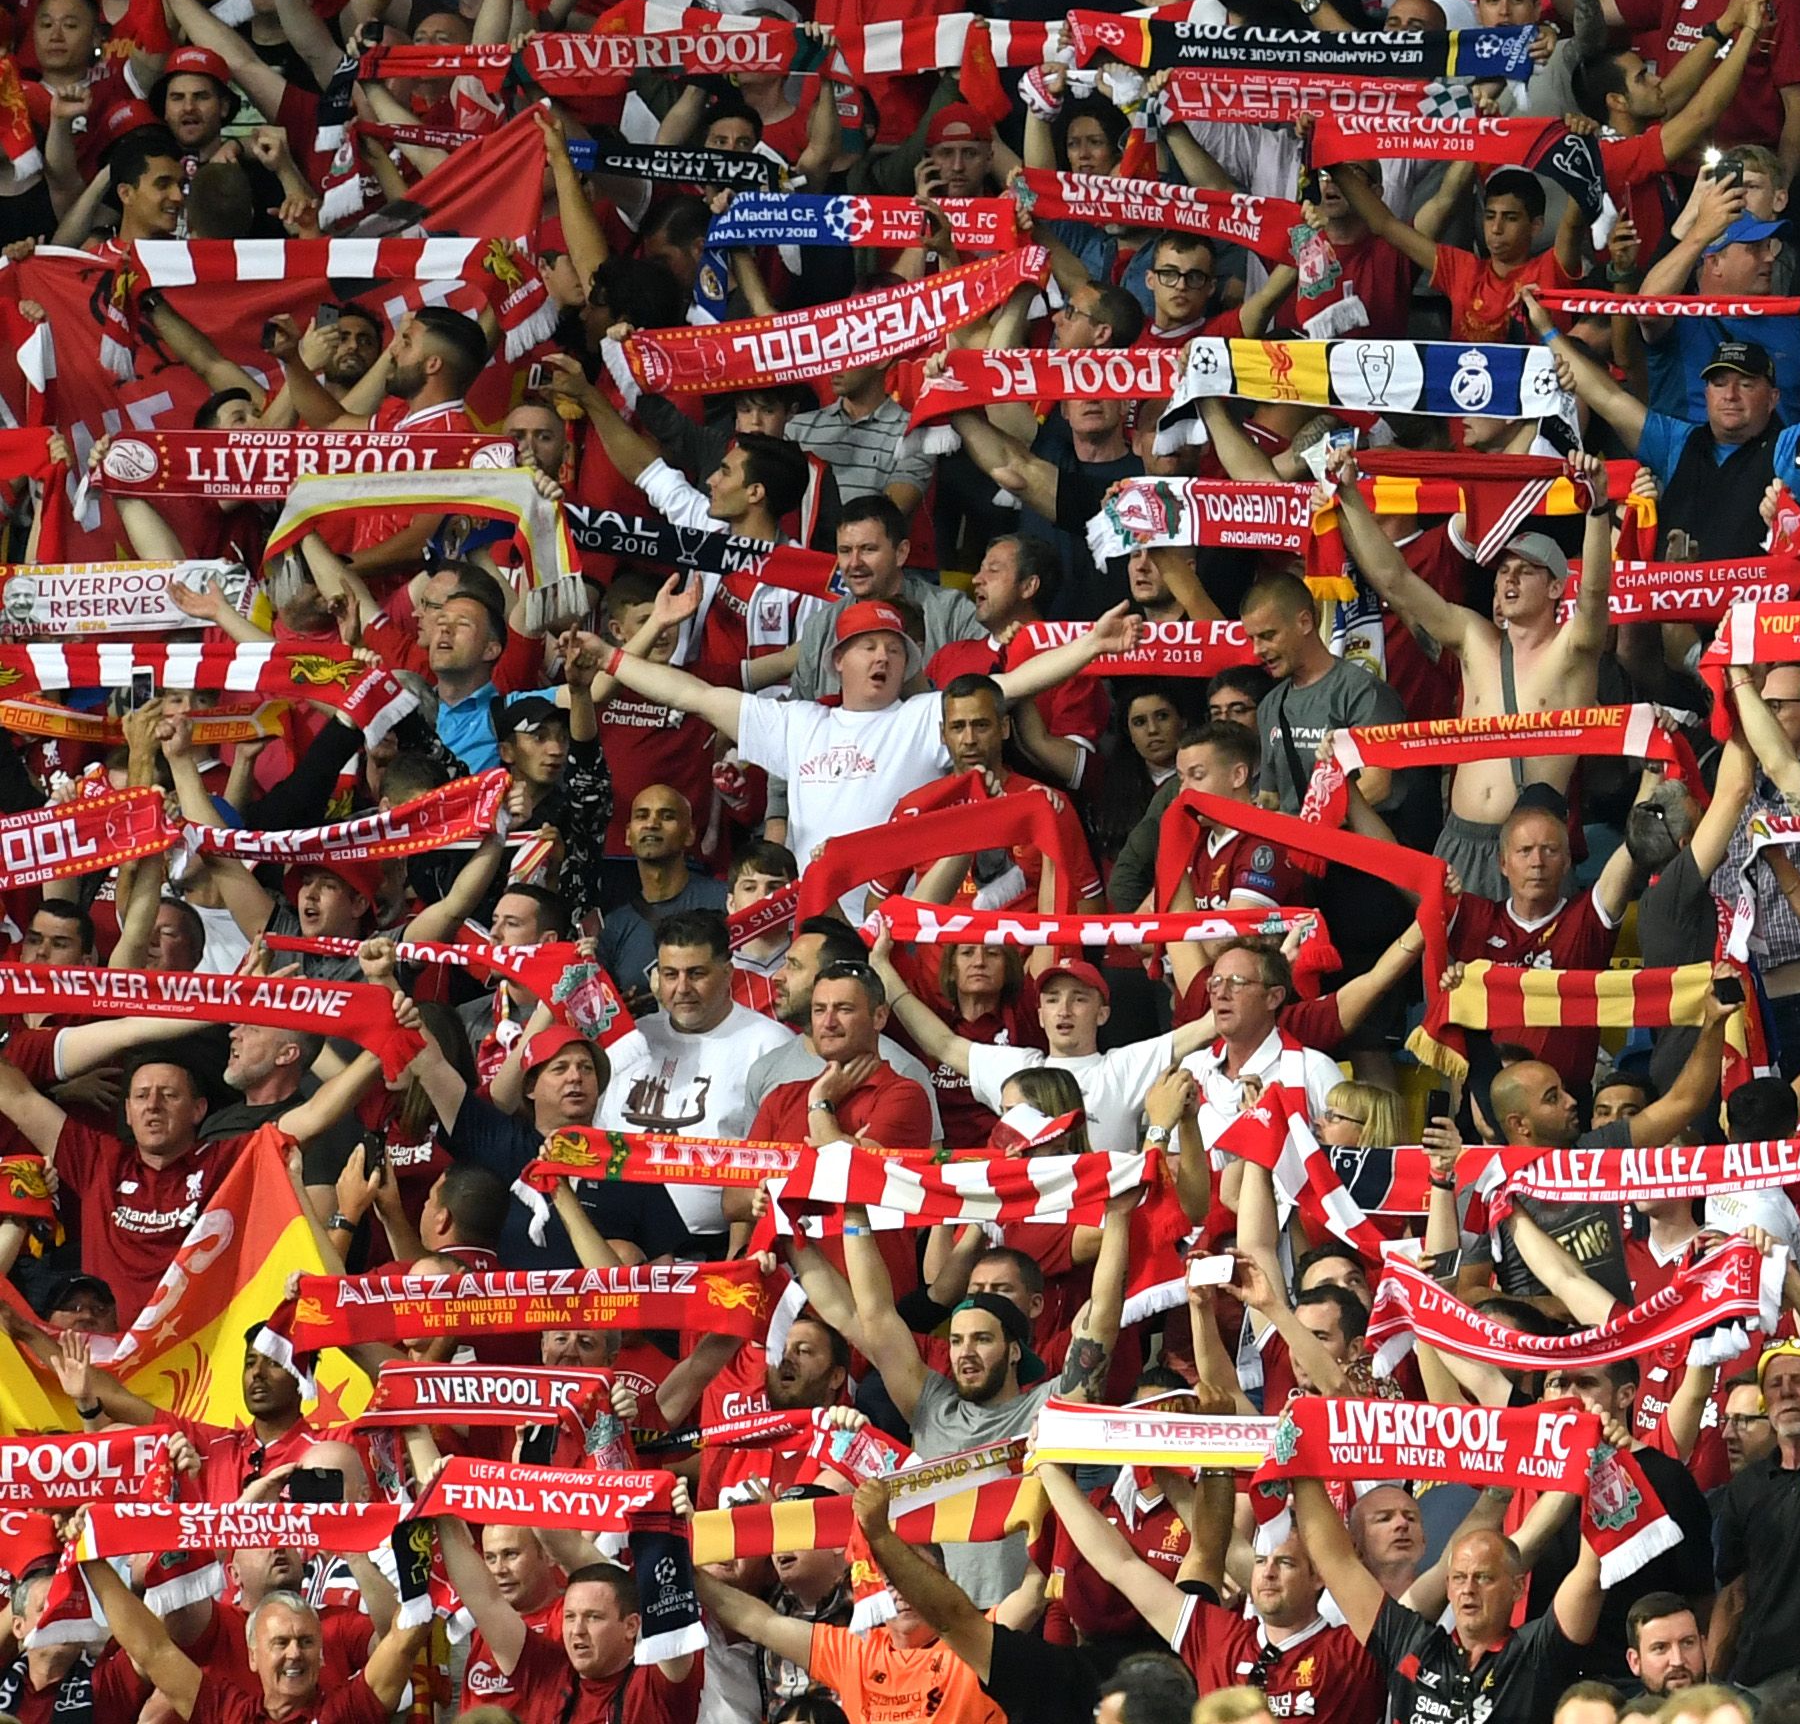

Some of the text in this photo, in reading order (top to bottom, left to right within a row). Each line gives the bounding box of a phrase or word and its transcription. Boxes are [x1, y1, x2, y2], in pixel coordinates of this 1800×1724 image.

[535, 35, 784, 72] LIVERPOOL
[1173, 82, 1400, 117] LIVERPOOL
[230, 433, 411, 448] PROUD TO BE A RED!
[1195, 494, 1311, 528] FC LIVERPOOL
[1616, 566, 1766, 588] CHAMPIONS LEAGUE
[50, 594, 165, 617] RESERVES
[1648, 583, 1790, 611] KYIV 2018
[3, 622, 67, 633] SHANKLY
[58, 970, 355, 1017] NEVER WALK ALONE
[1513, 1148, 1604, 1187] ALLEZ
[1622, 1145, 1711, 1184] ALLEZ
[414, 1377, 581, 1408] LIVERPOOL FC
[1327, 1399, 1575, 1458] LIVERPOOL FC
[470, 1463, 654, 1490] UEFA CHAMPIONS LEAGUE
[1327, 1445, 1566, 1479] YOU'LL NEVER WALK ALONE
[444, 1483, 612, 1517] FINAL KYIV
[180, 1513, 310, 1536] STADIUM
[177, 1532, 318, 1549] 26TH MAY 2018
